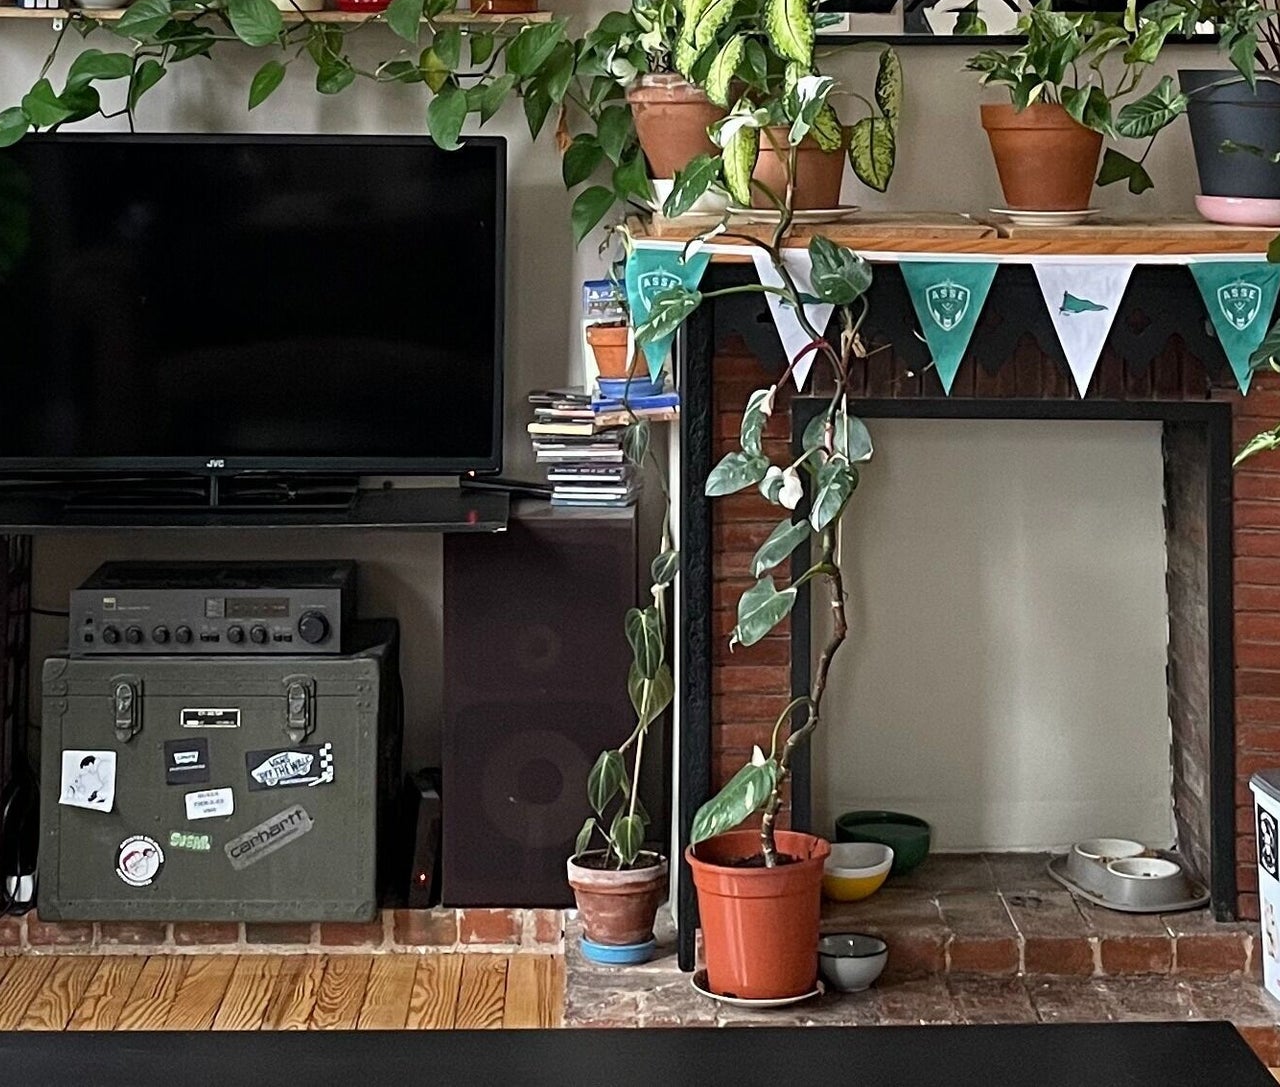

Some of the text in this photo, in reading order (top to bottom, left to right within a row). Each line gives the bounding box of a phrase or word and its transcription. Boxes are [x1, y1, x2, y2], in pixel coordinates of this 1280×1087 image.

[932, 288, 966, 301] ASSE
[1223, 288, 1257, 300] ASSE
[206, 459, 225, 468] JVC
[229, 809, 303, 859] carhartt
